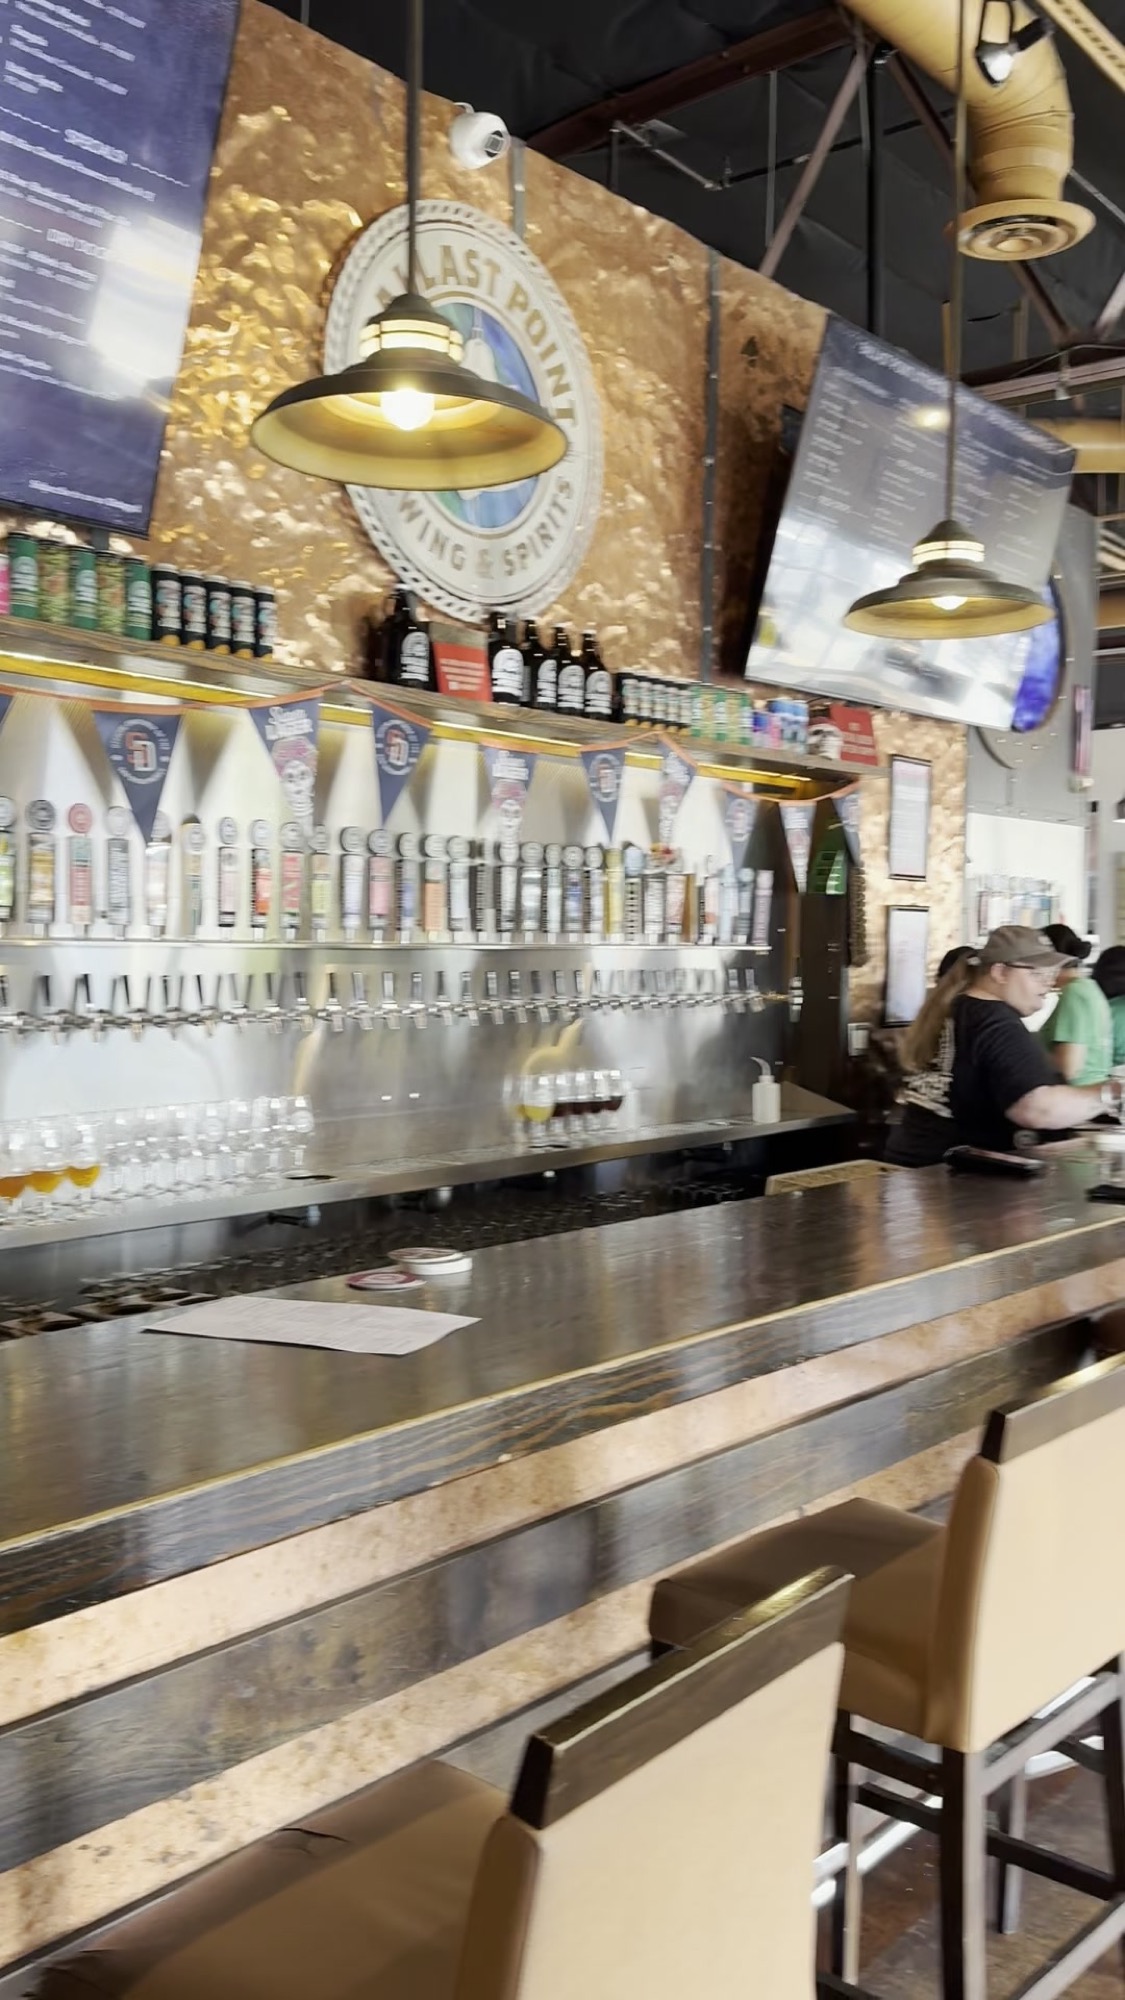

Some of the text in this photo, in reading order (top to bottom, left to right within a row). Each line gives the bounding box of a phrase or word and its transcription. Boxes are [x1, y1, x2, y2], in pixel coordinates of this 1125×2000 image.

[376, 245, 578, 427] ALLAST POINT
[394, 479, 574, 579] WING & SPIRITS
[125, 731, 157, 772] SD
